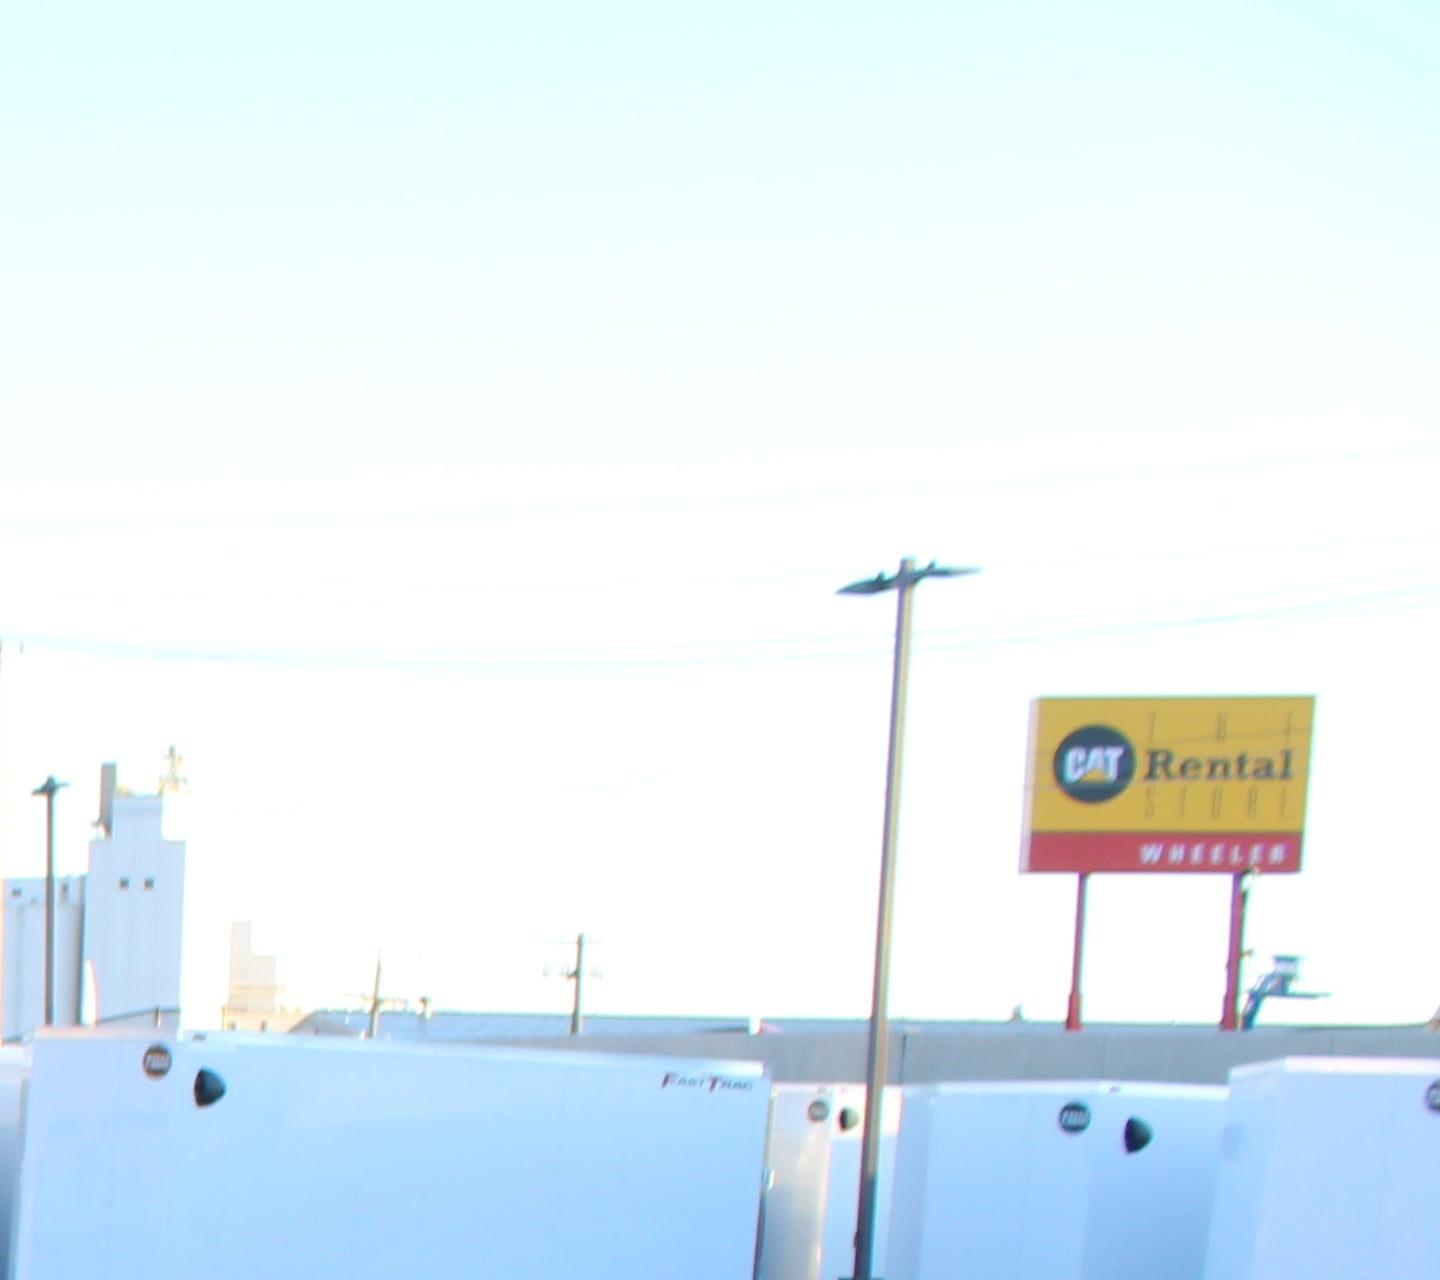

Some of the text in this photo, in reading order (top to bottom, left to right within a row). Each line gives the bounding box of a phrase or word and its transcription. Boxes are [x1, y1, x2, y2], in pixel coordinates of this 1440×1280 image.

[1064, 744, 1293, 785] CAT Rental
[1139, 843, 1287, 866] WHEELER
